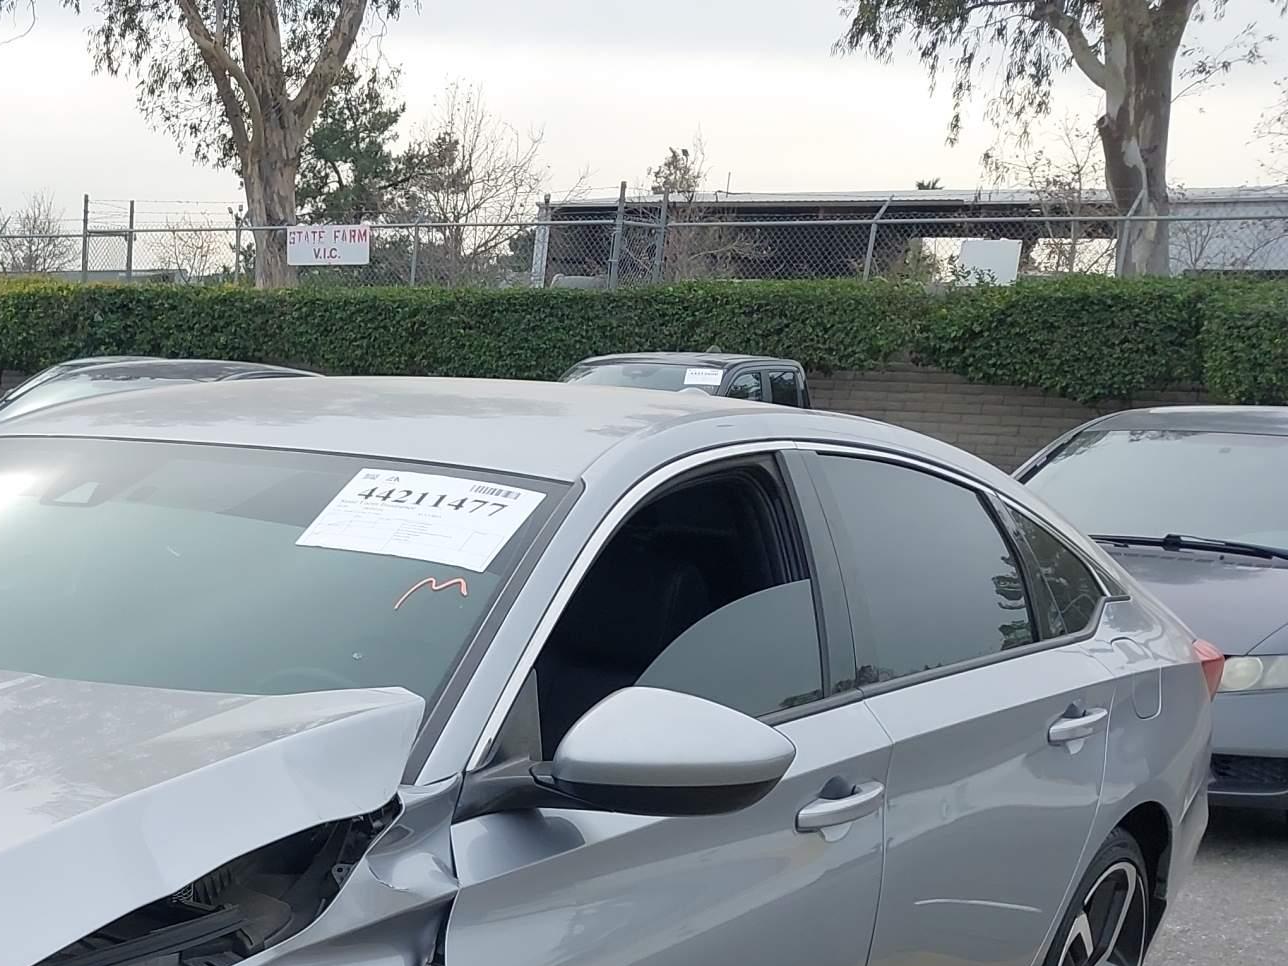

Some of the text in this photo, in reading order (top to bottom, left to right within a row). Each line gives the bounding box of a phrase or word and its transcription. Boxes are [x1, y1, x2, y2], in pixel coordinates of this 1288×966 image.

[289, 229, 367, 244] STATE FARM
[313, 247, 341, 260] V.I.C.
[357, 486, 509, 517] 44211477
